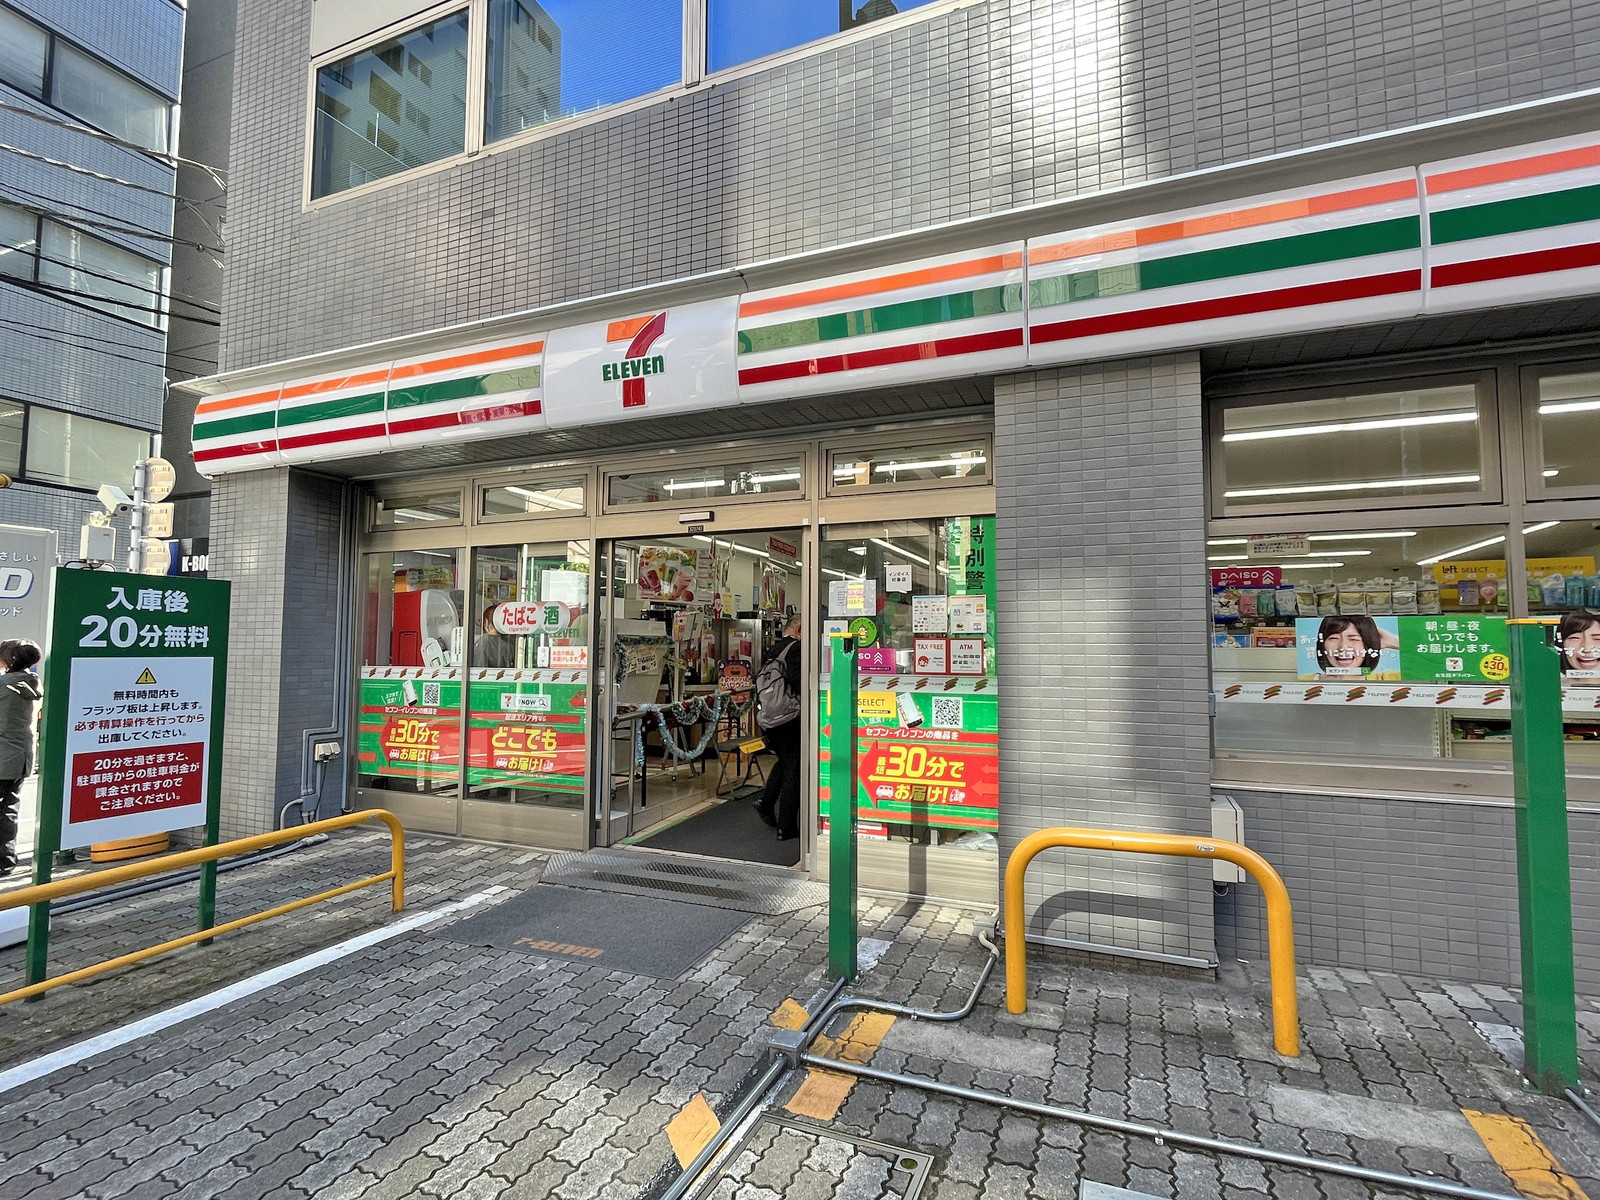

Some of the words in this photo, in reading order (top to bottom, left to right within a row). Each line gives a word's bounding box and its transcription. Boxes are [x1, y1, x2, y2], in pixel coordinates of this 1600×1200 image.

[1220, 571, 1259, 579] DAISO
[106, 586, 190, 614] 入庫後
[502, 605, 537, 625] たばこ
[543, 605, 560, 625] 酒
[78, 614, 210, 648] 20分無料
[1425, 620, 1480, 631] 朝・昼・夜
[1428, 632, 1479, 642] いつでも
[1416, 643, 1495, 654] お届けします。
[113, 688, 179, 701] 無料時間内も
[82, 701, 203, 716] フラップ板は上昇します。
[74, 713, 205, 732] 必ず精算操作を行ってから
[98, 728, 187, 744] 出庫してください。
[491, 726, 557, 751] どこでも
[93, 751, 189, 771] 20分を過ぎますと、
[76, 762, 200, 787] 駐車時からの駐車料金が
[95, 777, 184, 799] 課金されますので
[894, 783, 949, 804] お届け!
[100, 791, 181, 812] ご注意ください。
